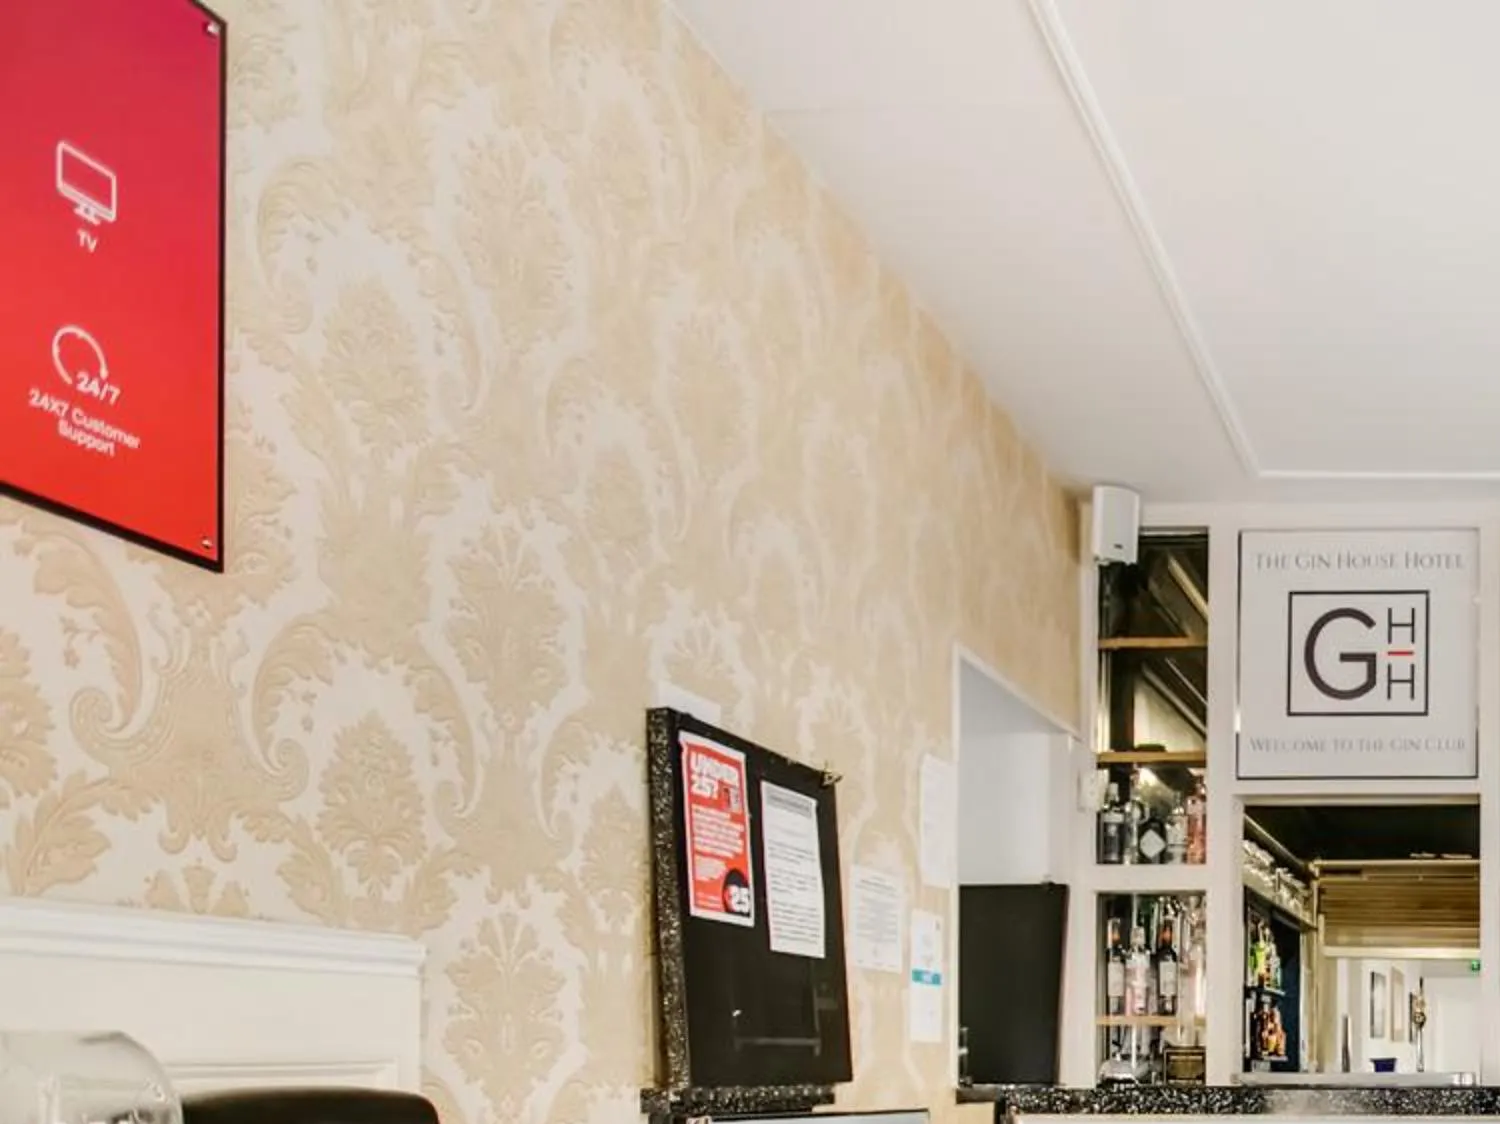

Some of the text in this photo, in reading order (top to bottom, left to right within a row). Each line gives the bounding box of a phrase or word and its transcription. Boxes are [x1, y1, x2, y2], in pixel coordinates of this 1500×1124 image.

[76, 228, 98, 253] TV
[76, 371, 121, 405] 24/7
[58, 419, 115, 457] Support
[71, 407, 141, 449] Customer
[1256, 551, 1465, 570] THE GIN HOUSE HOTEL
[1249, 736, 1327, 753] WELCOME
[1332, 737, 1354, 753] TO
[1389, 737, 1422, 752] GIN
[1424, 737, 1466, 752] CLUB
